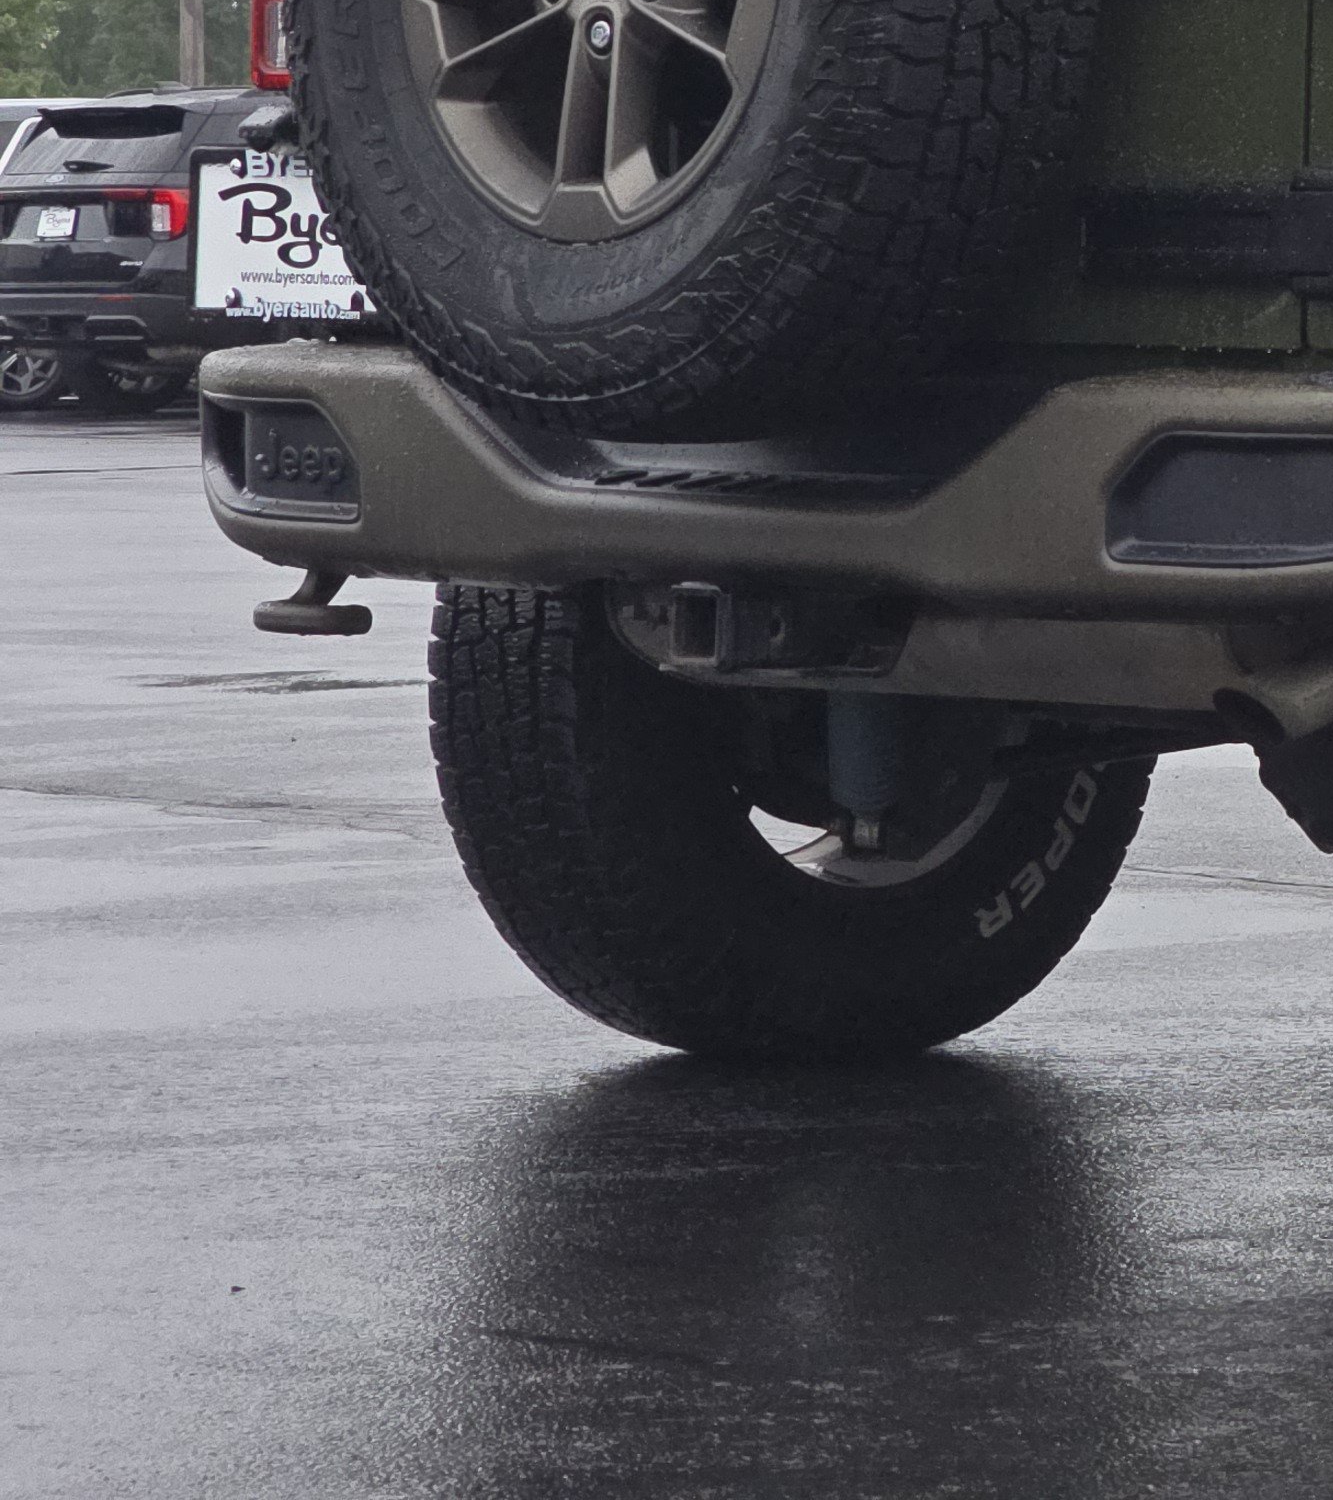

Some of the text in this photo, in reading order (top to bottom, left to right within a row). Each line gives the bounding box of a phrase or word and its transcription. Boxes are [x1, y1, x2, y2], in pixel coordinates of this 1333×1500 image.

[246, 151, 314, 178] BYE
[241, 269, 357, 288] www.byersauto.com
[226, 297, 361, 321] www.byersauto.com
[254, 428, 345, 494] Jeep
[974, 762, 1107, 937] OPER
